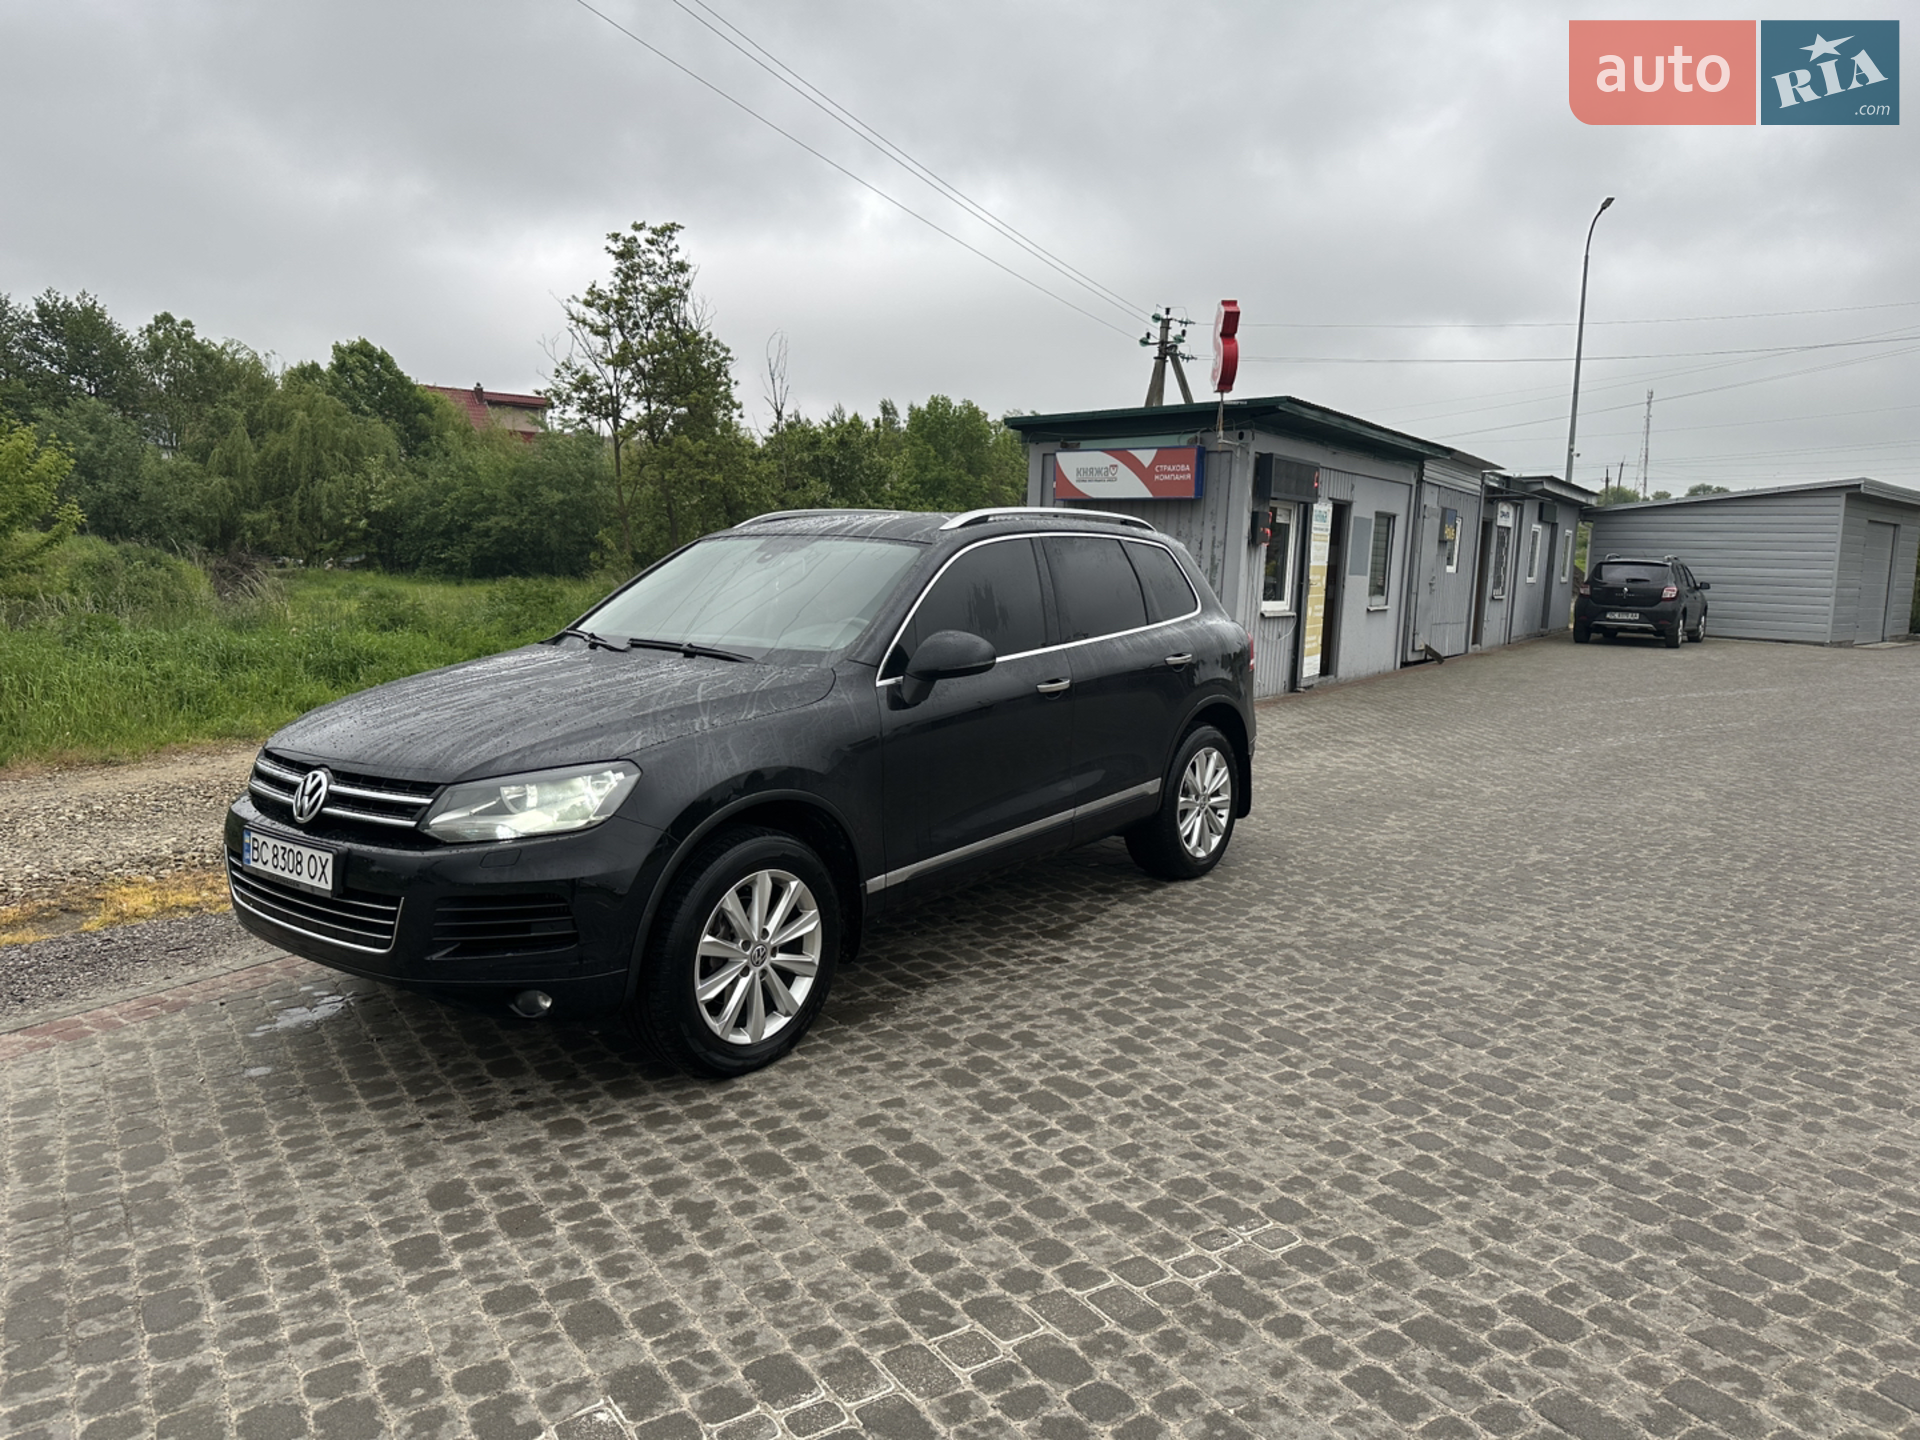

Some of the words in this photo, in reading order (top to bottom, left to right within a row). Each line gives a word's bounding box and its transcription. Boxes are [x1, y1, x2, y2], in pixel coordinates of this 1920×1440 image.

[1154, 464, 1190, 473] СТРАХОВА
[1153, 473, 1192, 482] КОМПАНІЯ
[252, 837, 269, 865] BC
[272, 844, 303, 876] 8308
[308, 854, 328, 884] OX
